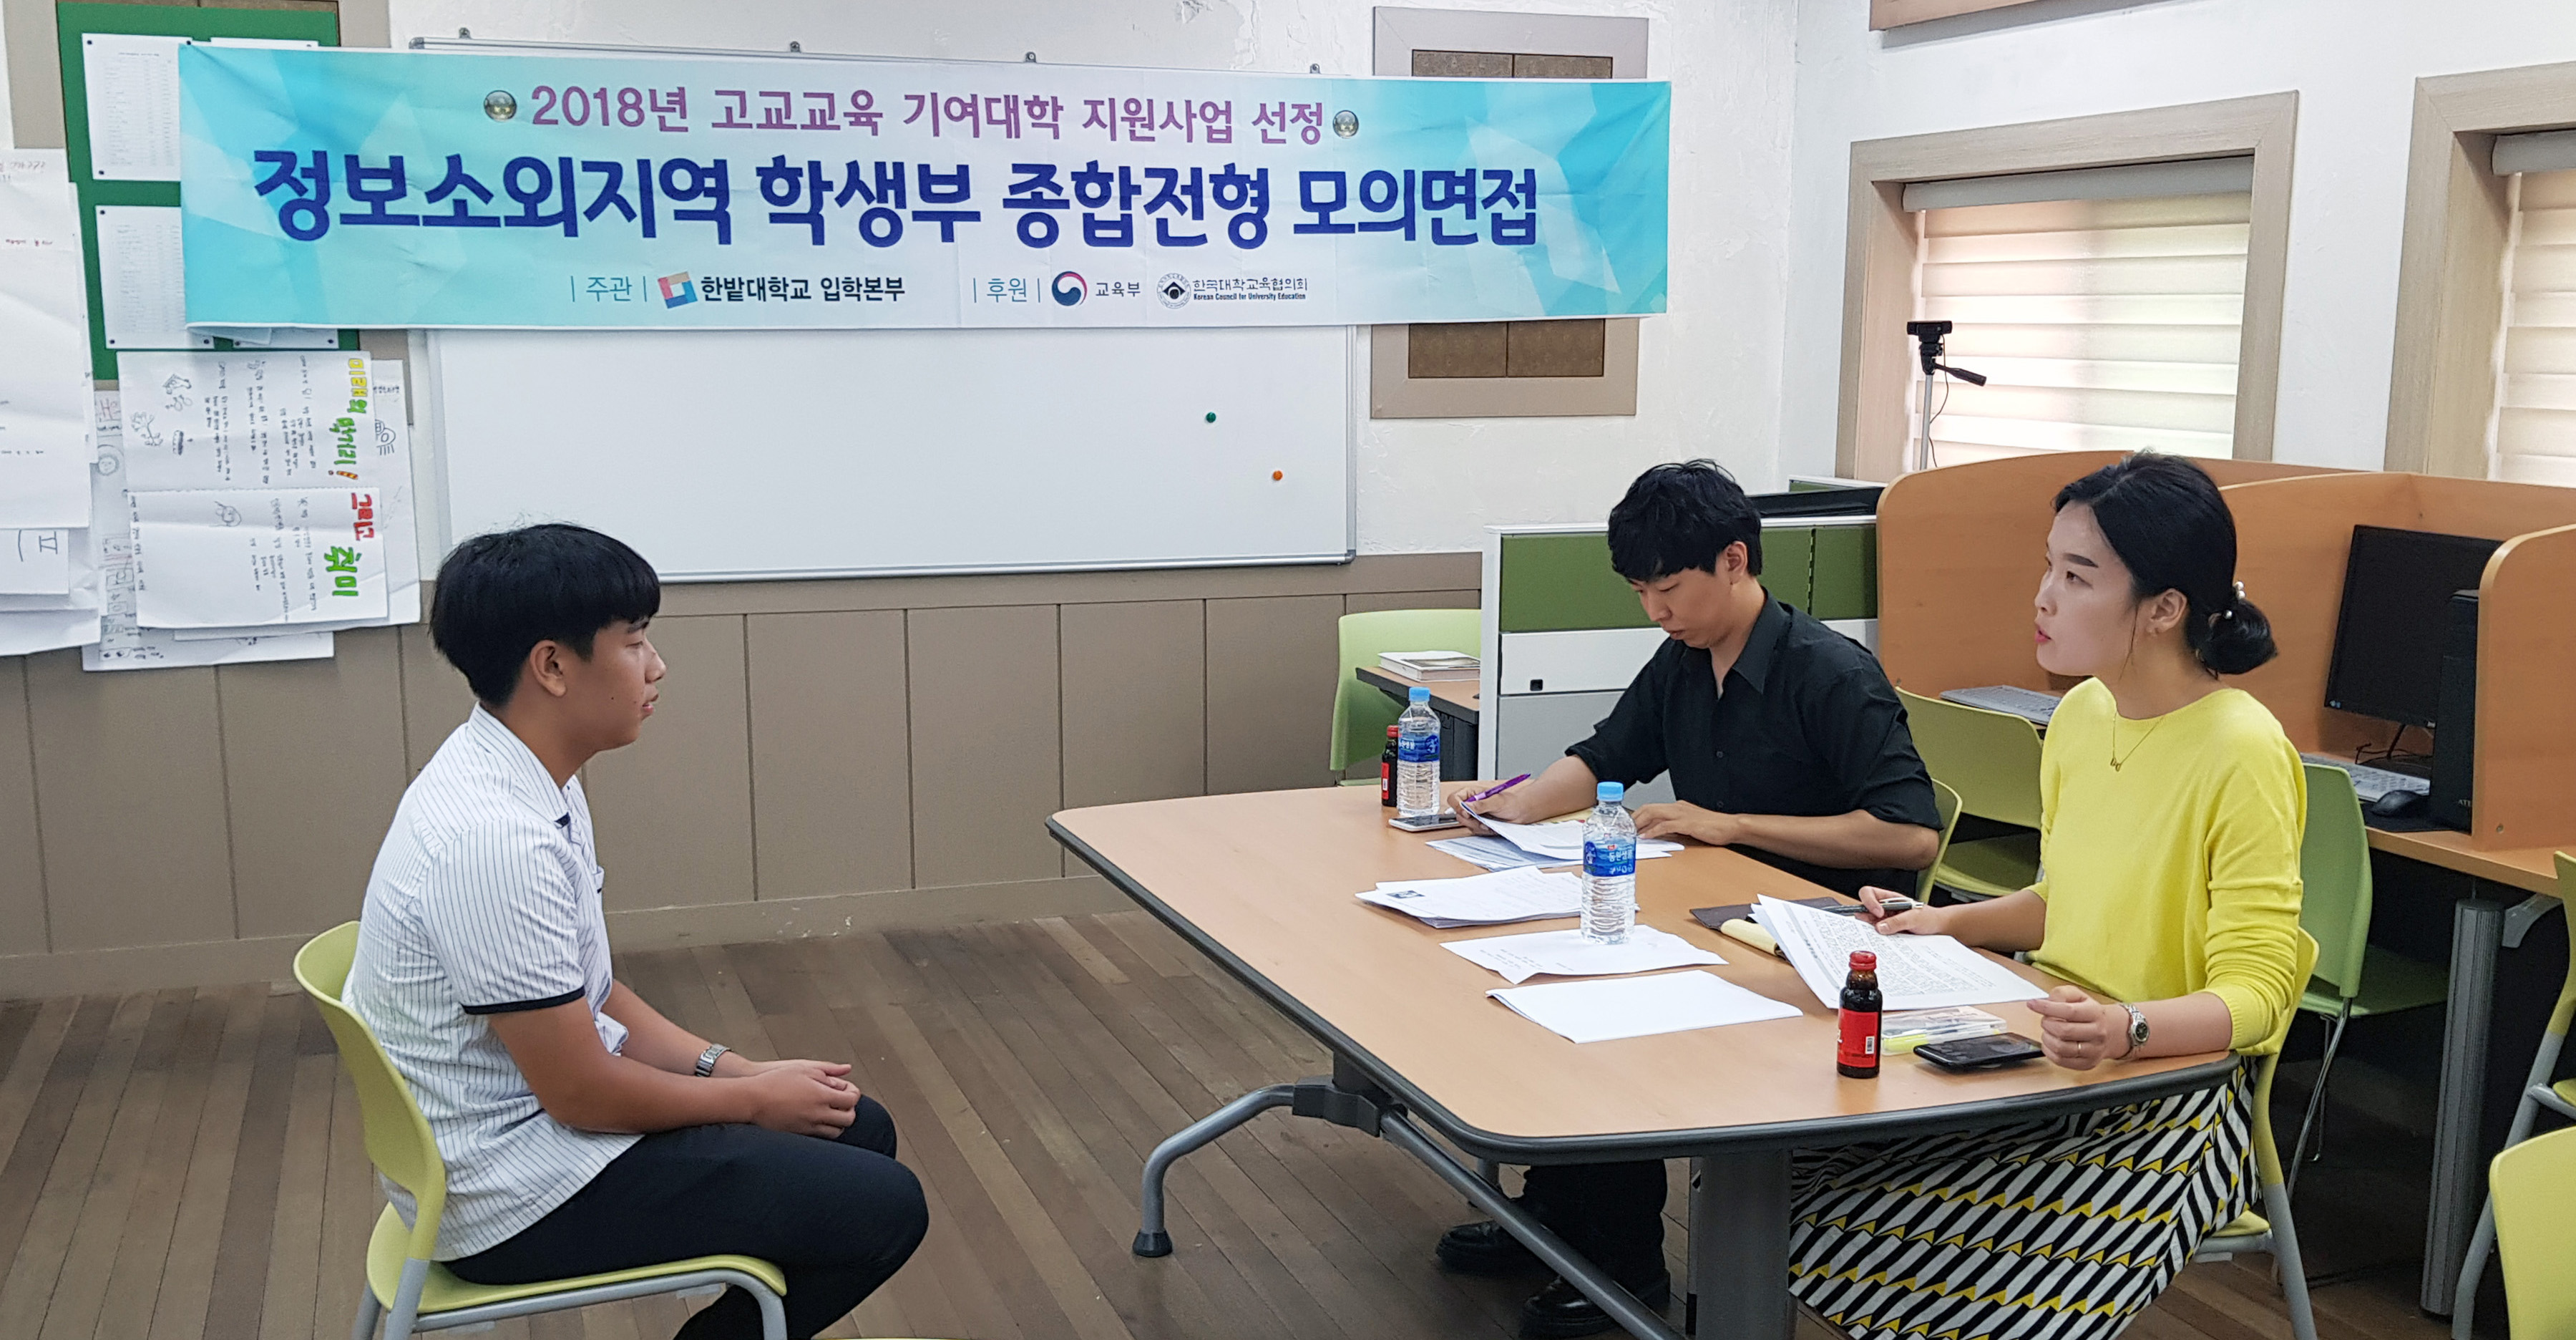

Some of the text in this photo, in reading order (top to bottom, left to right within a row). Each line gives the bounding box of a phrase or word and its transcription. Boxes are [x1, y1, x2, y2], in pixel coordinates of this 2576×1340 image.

[532, 85, 1323, 145] 2018년 고교교육 기여대학 지원사업 선정
[253, 150, 1537, 250] 정보소외지역 학생부 종합전형 모의면접
[586, 276, 906, 303] 주관 한밭대학교 입학본부
[986, 278, 1028, 303] 후원
[1096, 281, 1141, 298] 교육부
[1192, 276, 1308, 291] 한국대학교육협의회
[1248, 293, 1277, 301] University
[323, 545, 362, 597] 취미
